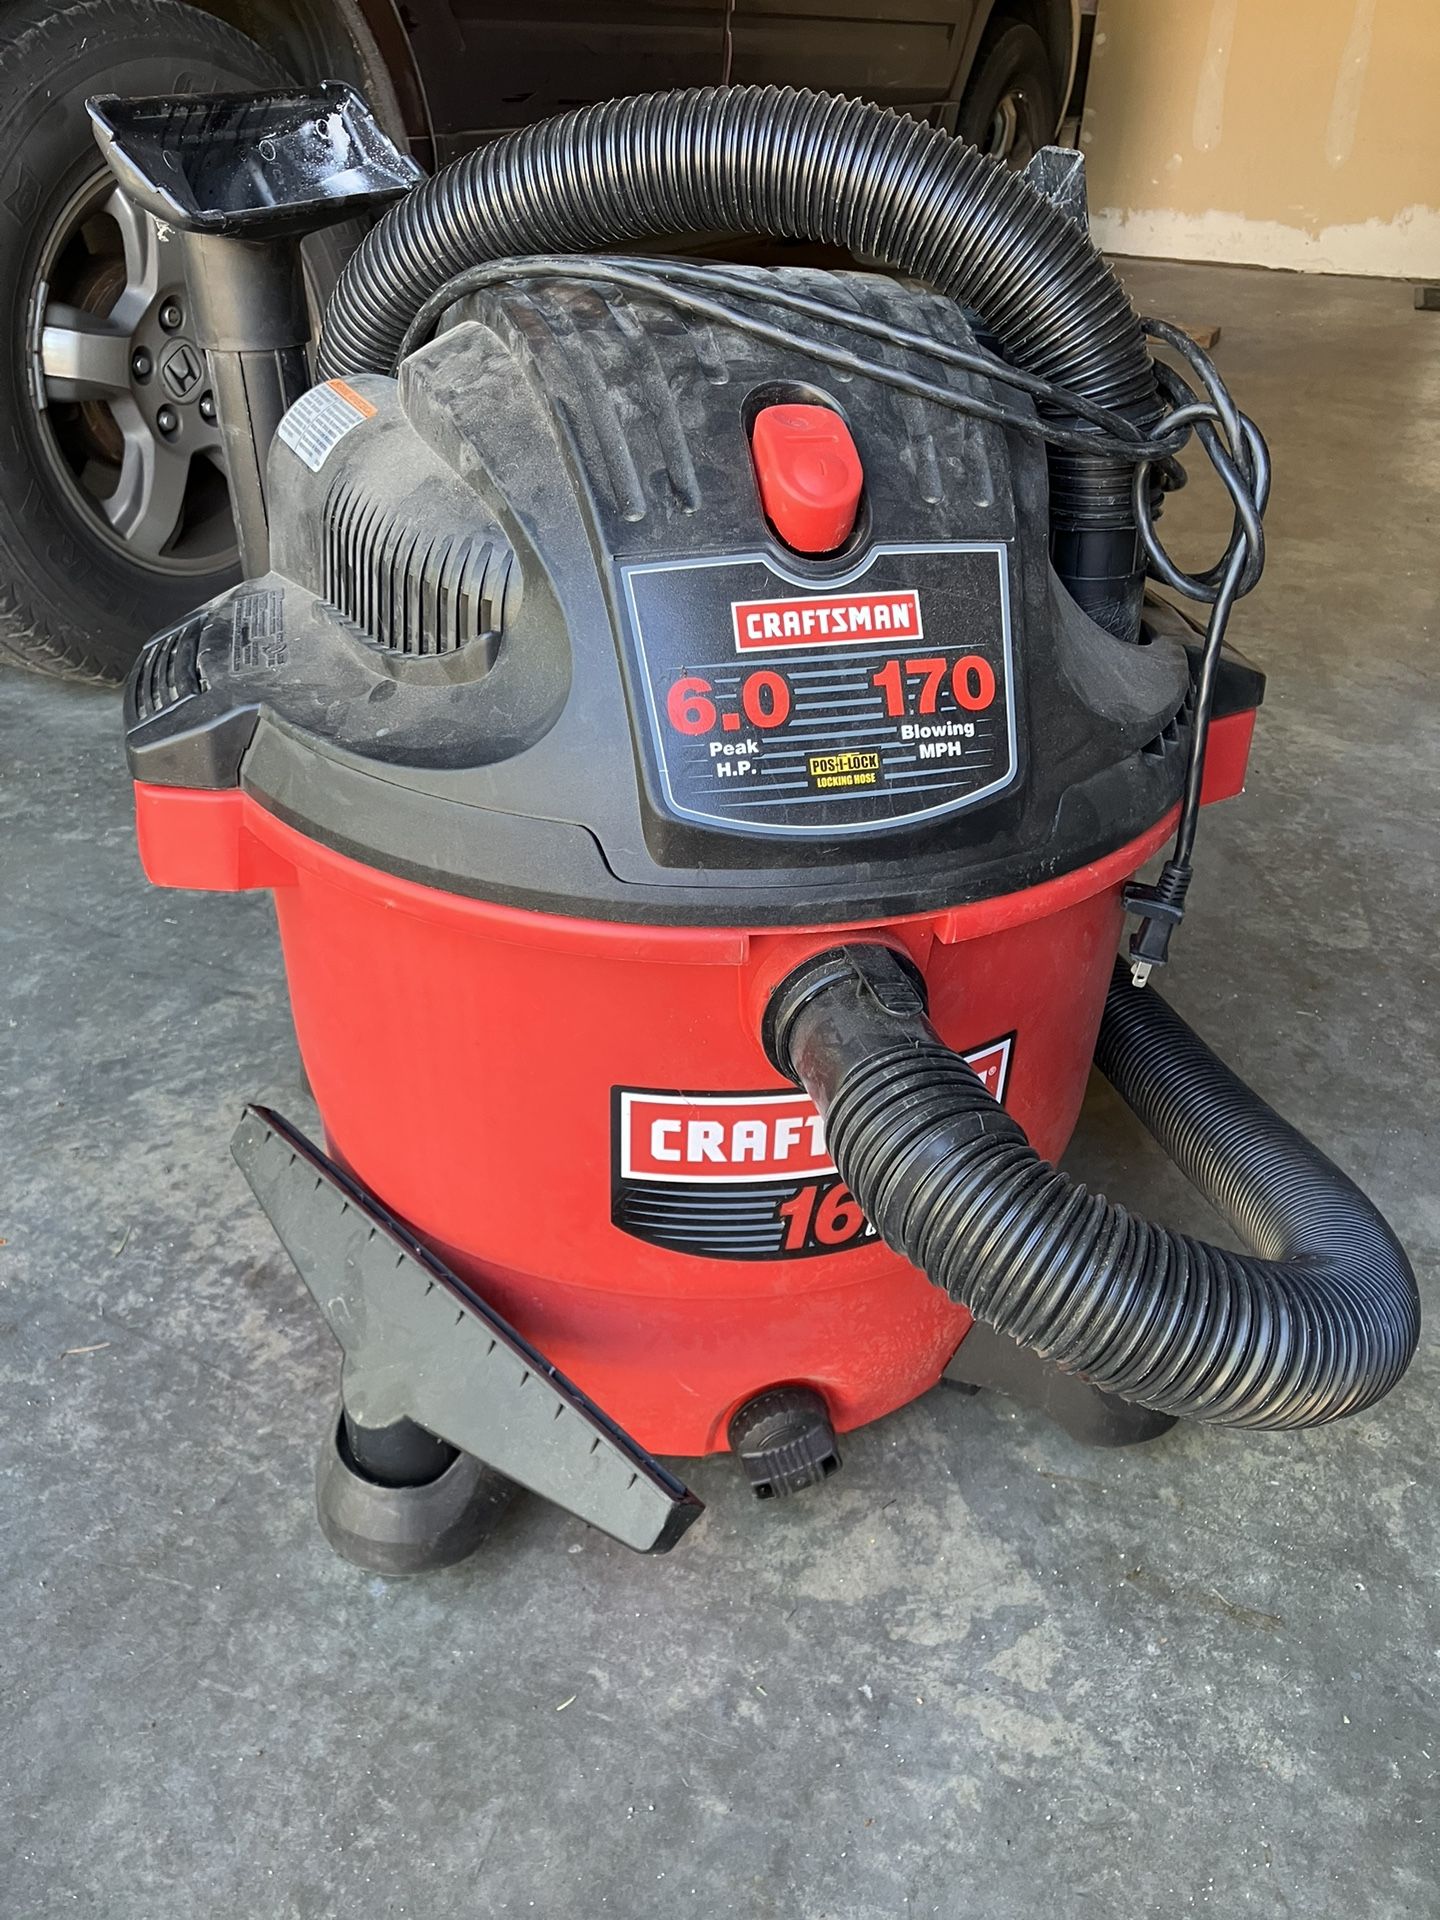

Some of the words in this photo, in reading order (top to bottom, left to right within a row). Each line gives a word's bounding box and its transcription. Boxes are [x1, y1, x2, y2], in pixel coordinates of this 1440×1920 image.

[873, 655, 995, 718] 170
[667, 671, 790, 736] 6.0
[901, 722, 975, 741] Blowing
[709, 738, 760, 758] Peak
[919, 741, 962, 760] MPH
[716, 760, 757, 778] H.P.
[817, 775, 853, 788] LOCKING
[855, 773, 876, 785] HOSE
[651, 1116, 828, 1162] CRAFT
[779, 1182, 865, 1251] 16
